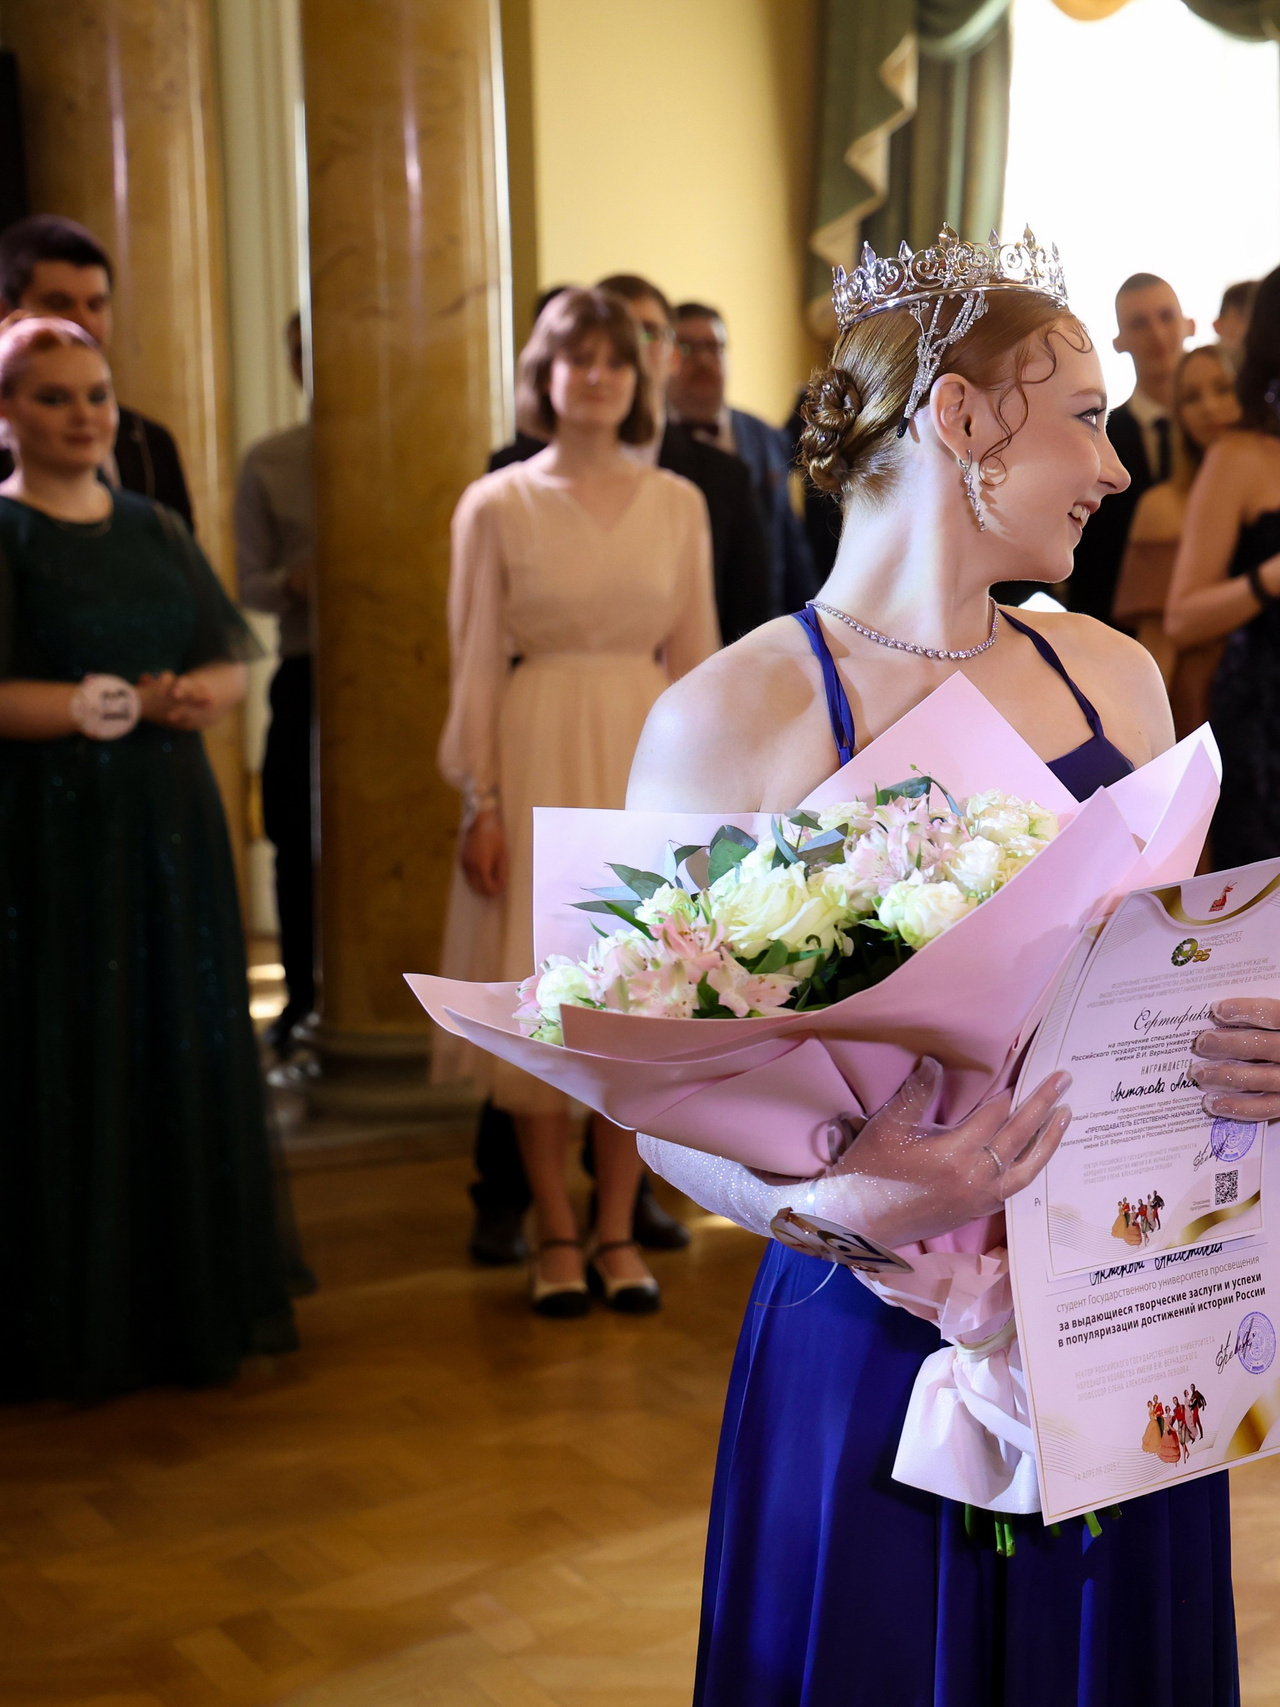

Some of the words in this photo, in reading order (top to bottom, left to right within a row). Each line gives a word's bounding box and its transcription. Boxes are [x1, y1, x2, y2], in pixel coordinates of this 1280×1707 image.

[1134, 1003, 1215, 1035] Сертифика
[1116, 1037, 1148, 1047] получение
[1150, 1030, 1190, 1042] специальной
[1148, 1045, 1188, 1056] Вернадского
[1070, 1050, 1110, 1061] Российского
[1110, 1042, 1162, 1056] государственного
[1084, 1120, 1132, 1133] «ПРЕПОДАВАТЕЛЬ
[1056, 1298, 1086, 1315] студент
[1088, 1281, 1156, 1306] Государственного
[1158, 1268, 1208, 1289] университета
[1208, 1255, 1260, 1276] просвещения
[1058, 1320, 1070, 1331] за
[1070, 1306, 1132, 1329] выдающиеся
[1134, 1293, 1186, 1313] творческие
[1188, 1284, 1222, 1301] заслуги
[1224, 1281, 1230, 1289] и
[1230, 1274, 1260, 1291] успехи
[1058, 1337, 1064, 1347] в
[1064, 1320, 1138, 1346] популяризации
[1140, 1303, 1196, 1325] достижений
[1196, 1296, 1234, 1313] истории
[1234, 1286, 1266, 1302] России
